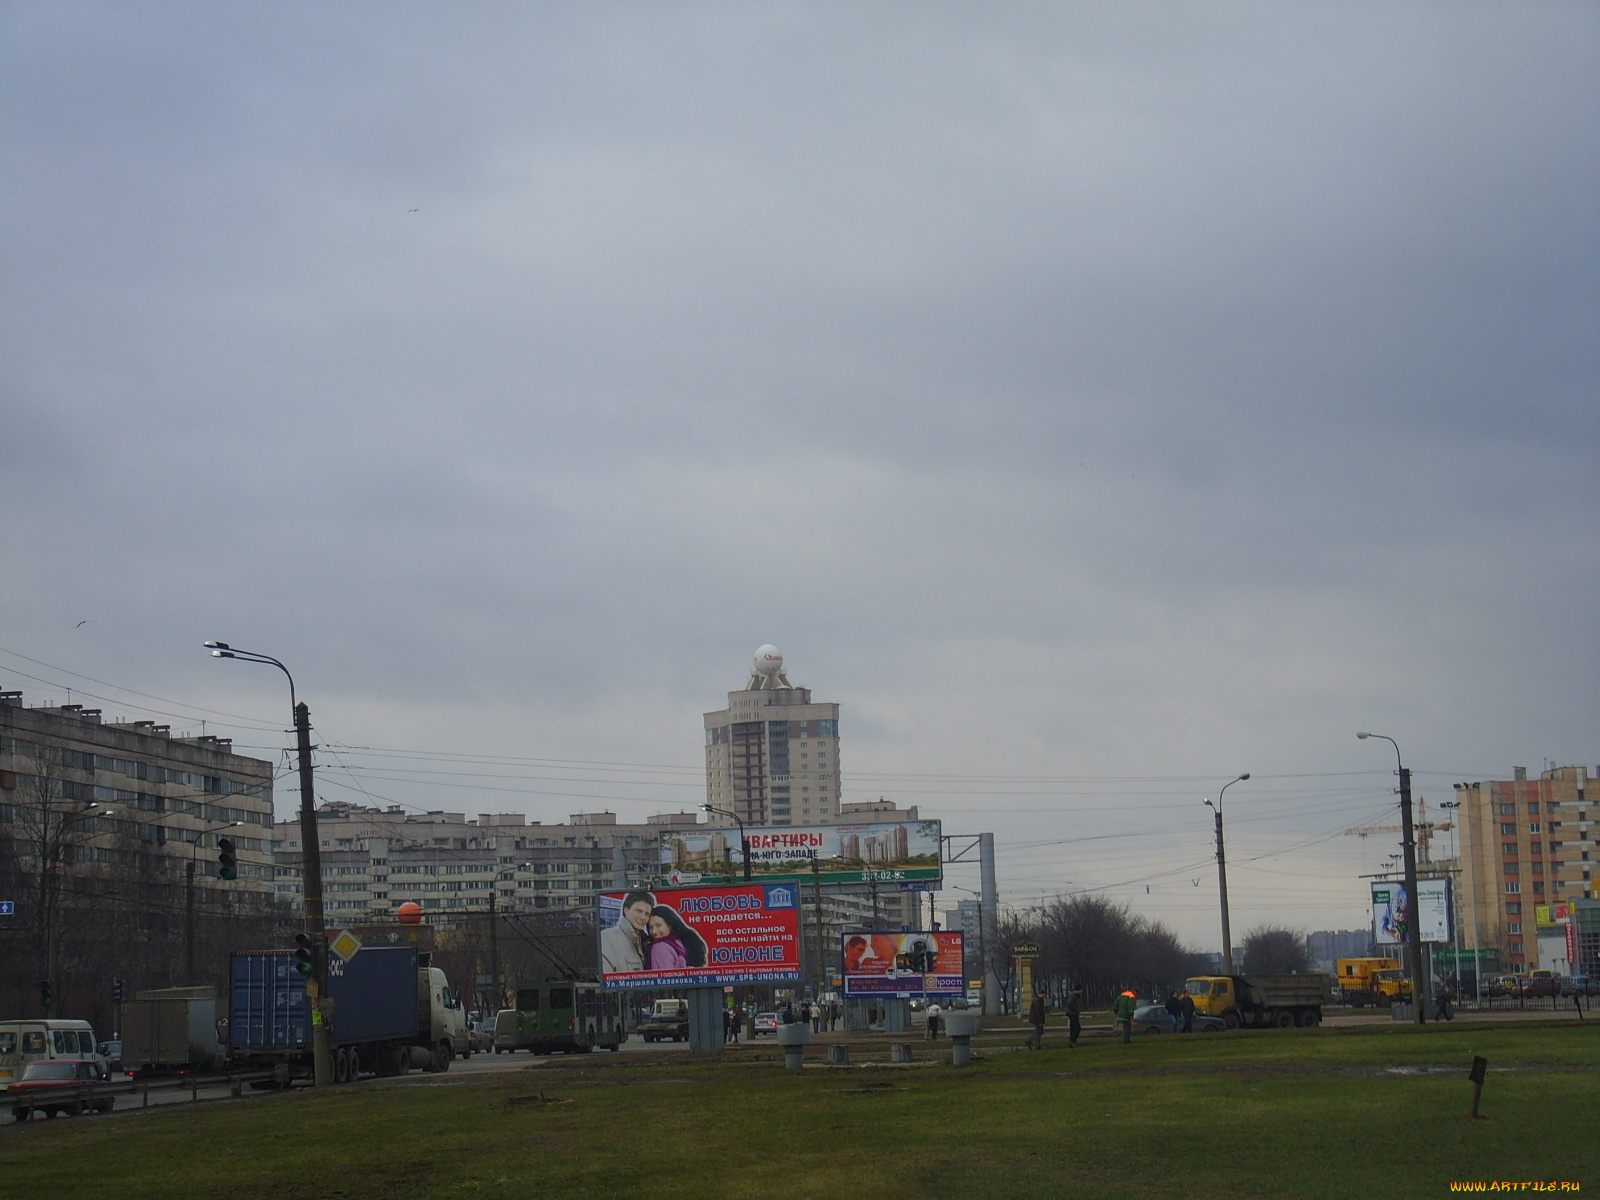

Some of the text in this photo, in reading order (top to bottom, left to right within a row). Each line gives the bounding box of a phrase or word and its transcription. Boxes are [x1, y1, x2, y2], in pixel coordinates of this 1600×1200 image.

[762, 849, 818, 859] ЮГО-ЗАПАДЕ
[679, 895, 761, 912] ЛЮБОВЬ
[689, 912, 772, 924] не продается...
[716, 926, 785, 936] все остальное
[716, 936, 748, 944] можно
[751, 933, 779, 943] найти
[711, 945, 785, 963] ЮНОНЕ
[656, 977, 696, 985] Казакова,
[716, 972, 799, 982] WWW.SPB-UNONA.RU
